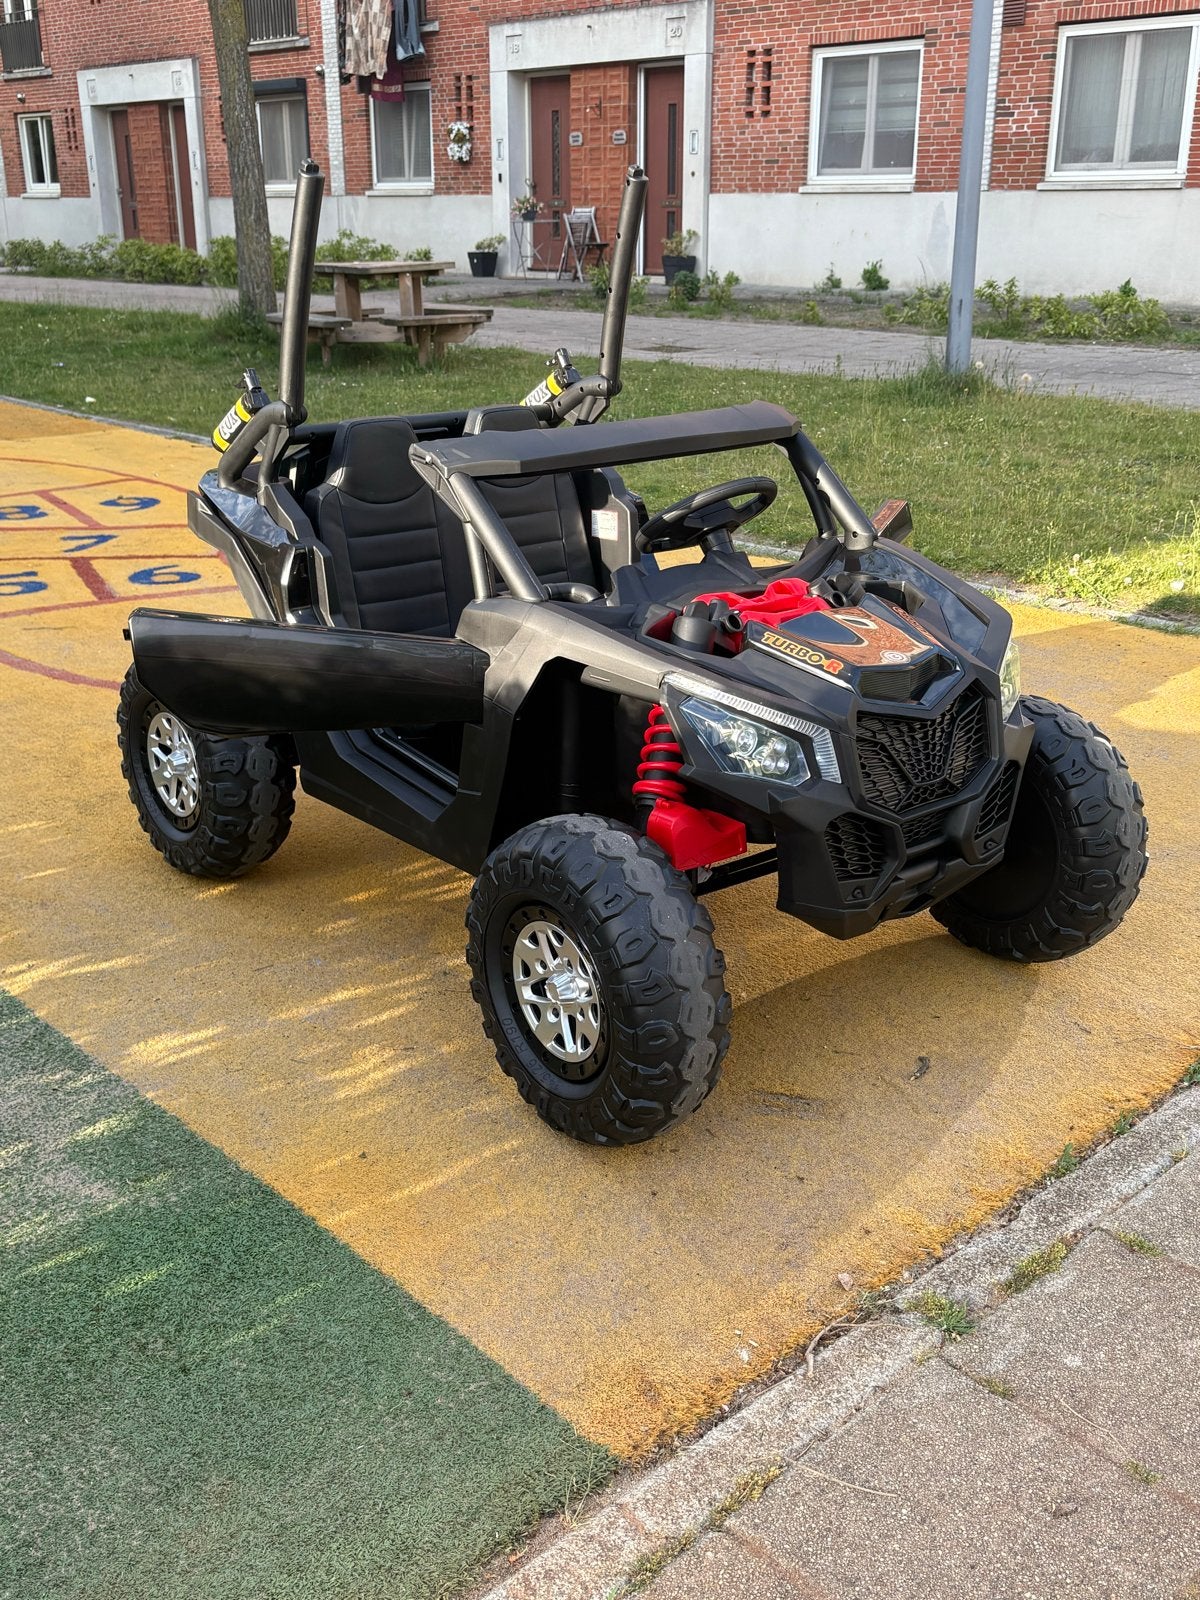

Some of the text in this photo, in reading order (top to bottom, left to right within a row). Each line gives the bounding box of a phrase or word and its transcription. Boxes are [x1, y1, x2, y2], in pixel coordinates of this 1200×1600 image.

[669, 25, 683, 39] 20
[99, 496, 161, 513] 9
[60, 534, 118, 553] 7
[128, 564, 201, 585] 6
[761, 631, 844, 674] TURBO-R
